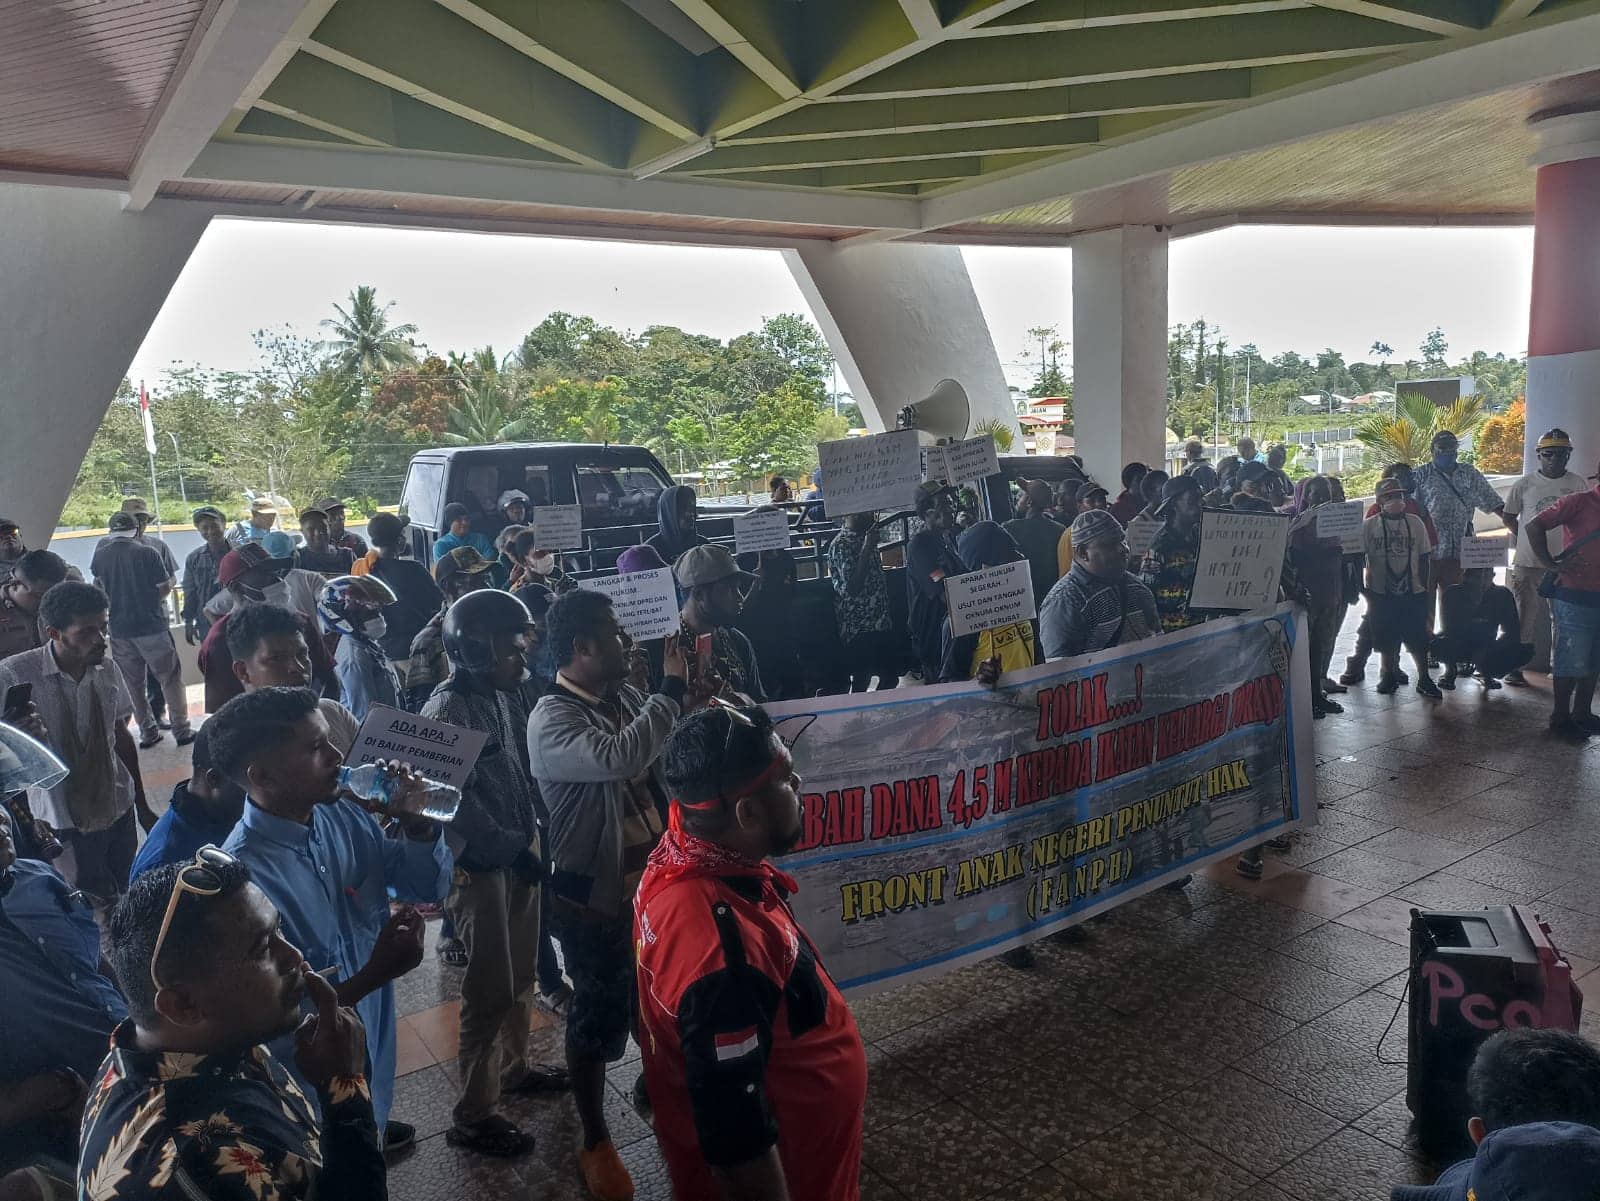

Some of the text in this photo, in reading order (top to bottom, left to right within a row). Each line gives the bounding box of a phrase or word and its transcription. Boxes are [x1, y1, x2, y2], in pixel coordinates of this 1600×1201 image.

[593, 576, 625, 588] TANGKAP
[633, 571, 659, 581] PROSES
[960, 566, 1016, 585] APARAT HUKUM
[957, 587, 1026, 610] USUT DAN TANGKAP
[653, 616, 671, 624] DANA
[969, 613, 1020, 631] YANG TERLIBAT
[390, 719, 418, 735] ADA
[364, 736, 464, 766] DI BALIK PEMBERIAN
[441, 771, 452, 781] M
[791, 786, 866, 852] BAH
[870, 774, 942, 840] DANA
[947, 764, 989, 829] 4,5
[992, 756, 1013, 814] M
[1015, 738, 1092, 808] KEPADA
[1095, 718, 1155, 783] IKATAN
[840, 865, 948, 925] FRONT
[954, 843, 1025, 900] ANAK
[1030, 813, 1112, 872] NEGERI
[1207, 759, 1250, 799] HAK
